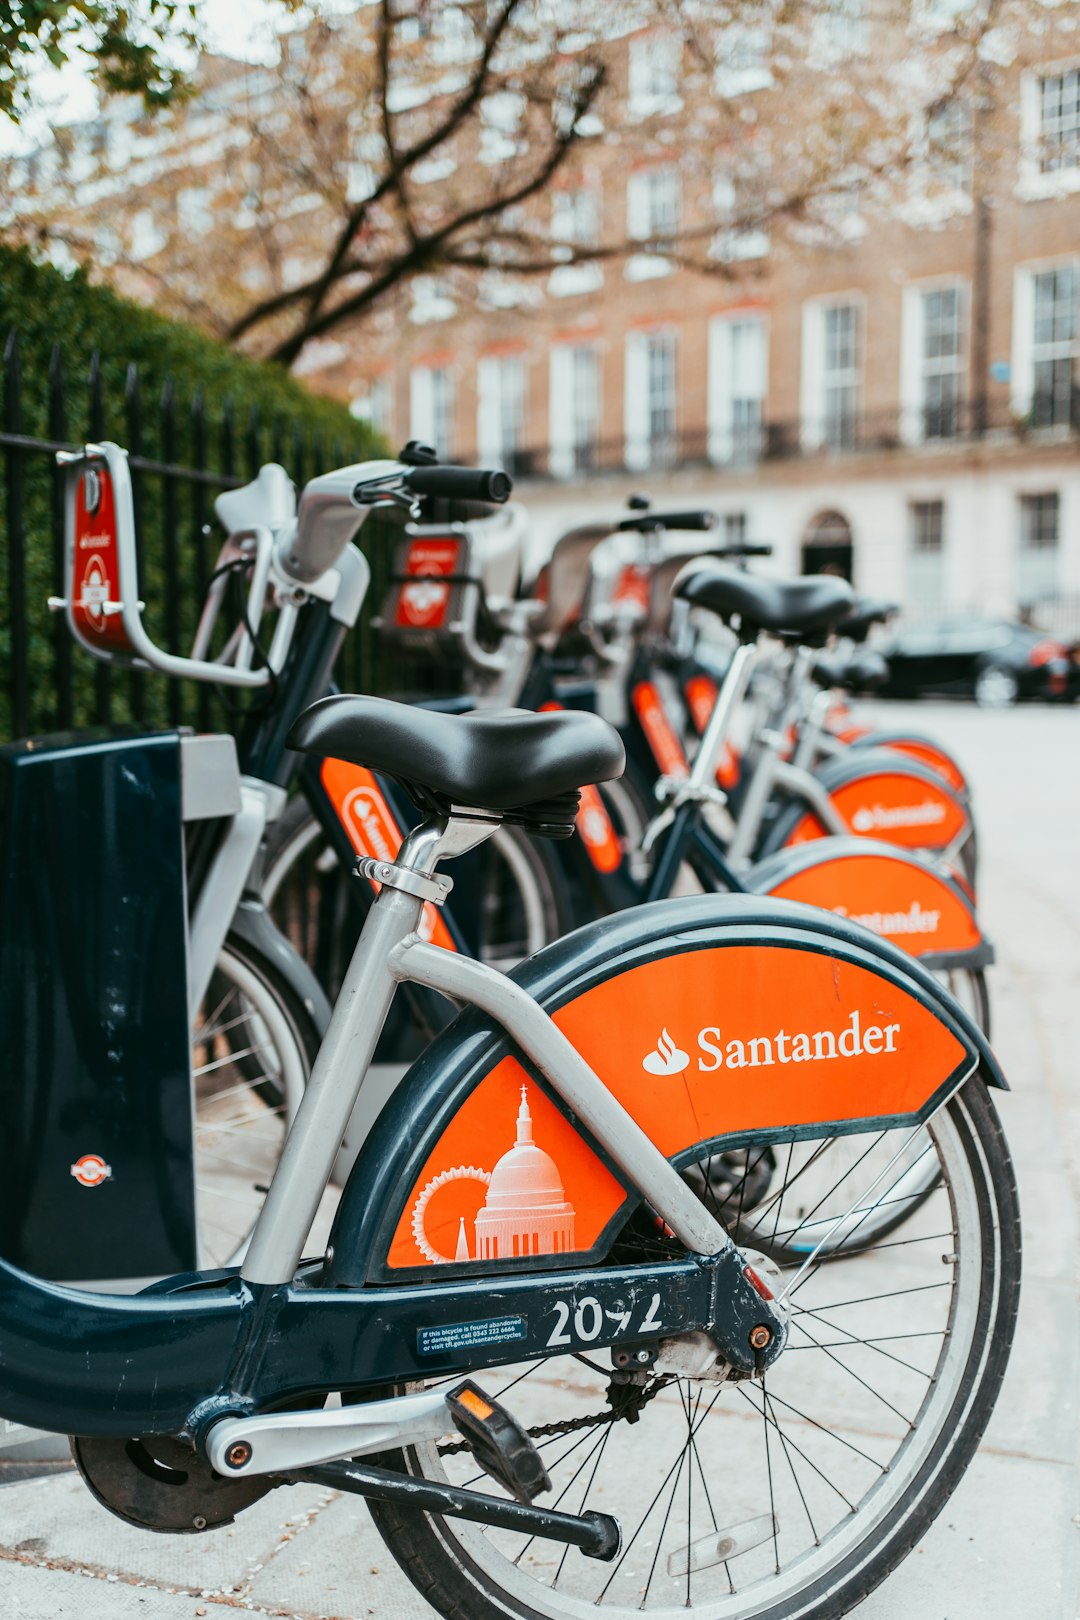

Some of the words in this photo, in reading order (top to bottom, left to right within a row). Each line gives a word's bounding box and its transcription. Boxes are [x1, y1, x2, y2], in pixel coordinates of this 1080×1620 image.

[697, 1010, 900, 1072] Santander
[441, 1328, 463, 1336] bicycle
[489, 1319, 522, 1329] abandoned
[445, 1332, 522, 1348] tfl.gov.uk/santandercycles
